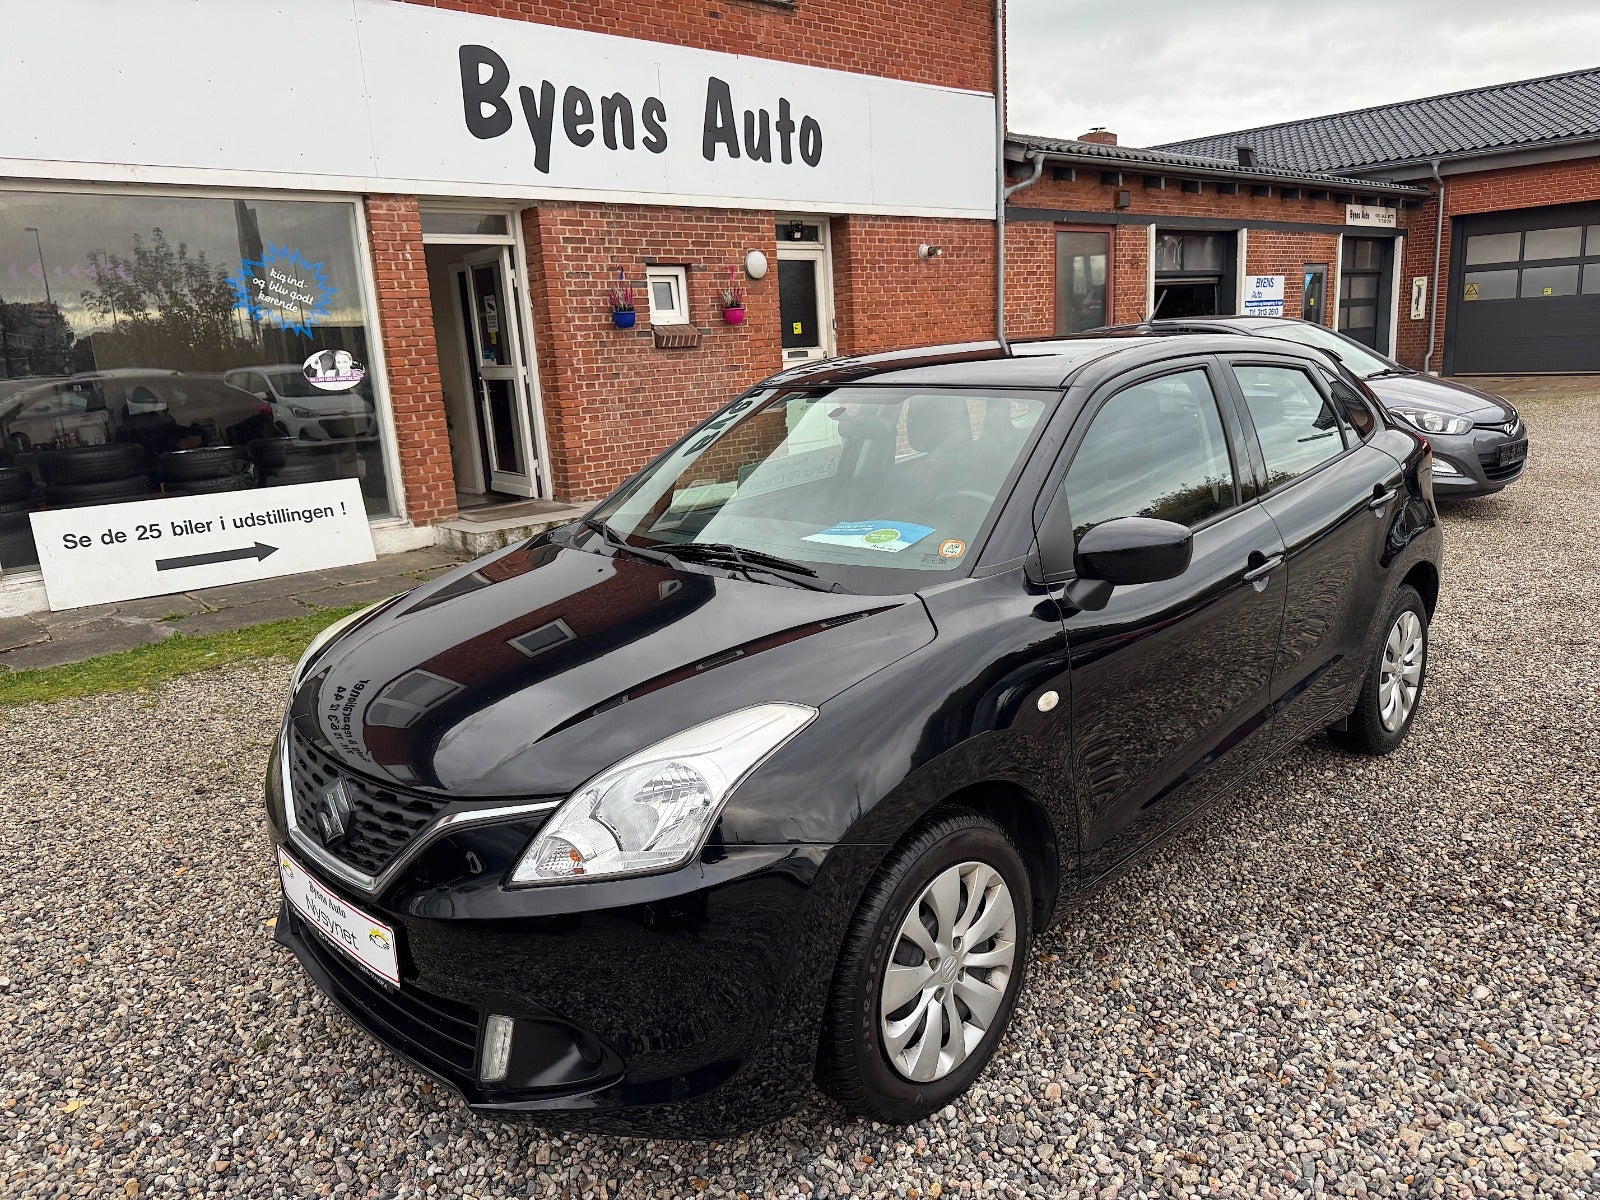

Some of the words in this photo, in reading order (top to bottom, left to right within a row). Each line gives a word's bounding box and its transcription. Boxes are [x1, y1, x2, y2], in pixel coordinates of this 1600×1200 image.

[459, 44, 667, 174] Byens
[702, 76, 822, 167] Auto
[270, 268, 286, 284] kig
[1255, 277, 1275, 288] BYENS
[252, 278, 265, 289] og
[269, 281, 288, 295] bliv
[289, 290, 314, 305] godt
[1251, 290, 1263, 299] Auto
[62, 533, 92, 550] Se
[100, 528, 127, 546] de
[135, 523, 162, 541] 25
[170, 519, 213, 537] biler
[219, 516, 226, 531] i
[232, 504, 335, 529] udstillingen
[340, 501, 347, 516] !
[305, 893, 359, 951] Nysynet
